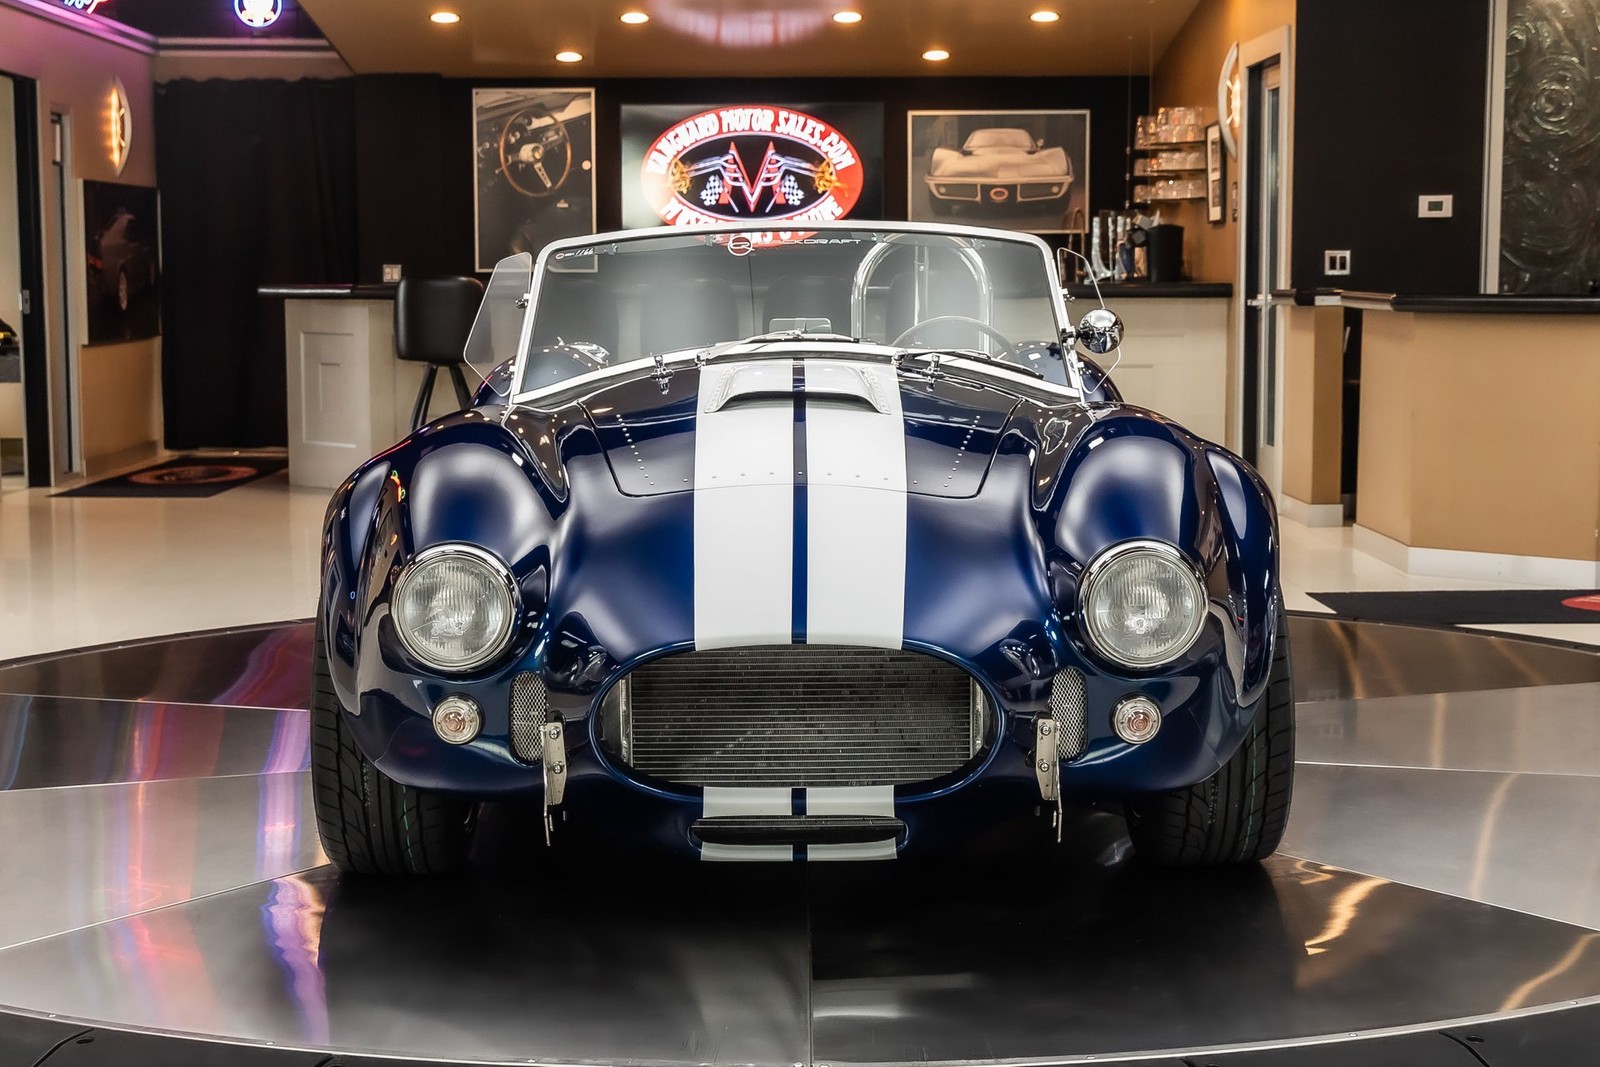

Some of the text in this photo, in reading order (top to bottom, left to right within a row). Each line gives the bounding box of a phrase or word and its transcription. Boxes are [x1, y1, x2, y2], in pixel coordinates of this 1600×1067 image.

[646, 108, 856, 174] VANGUARD MOTOR SALES.COM
